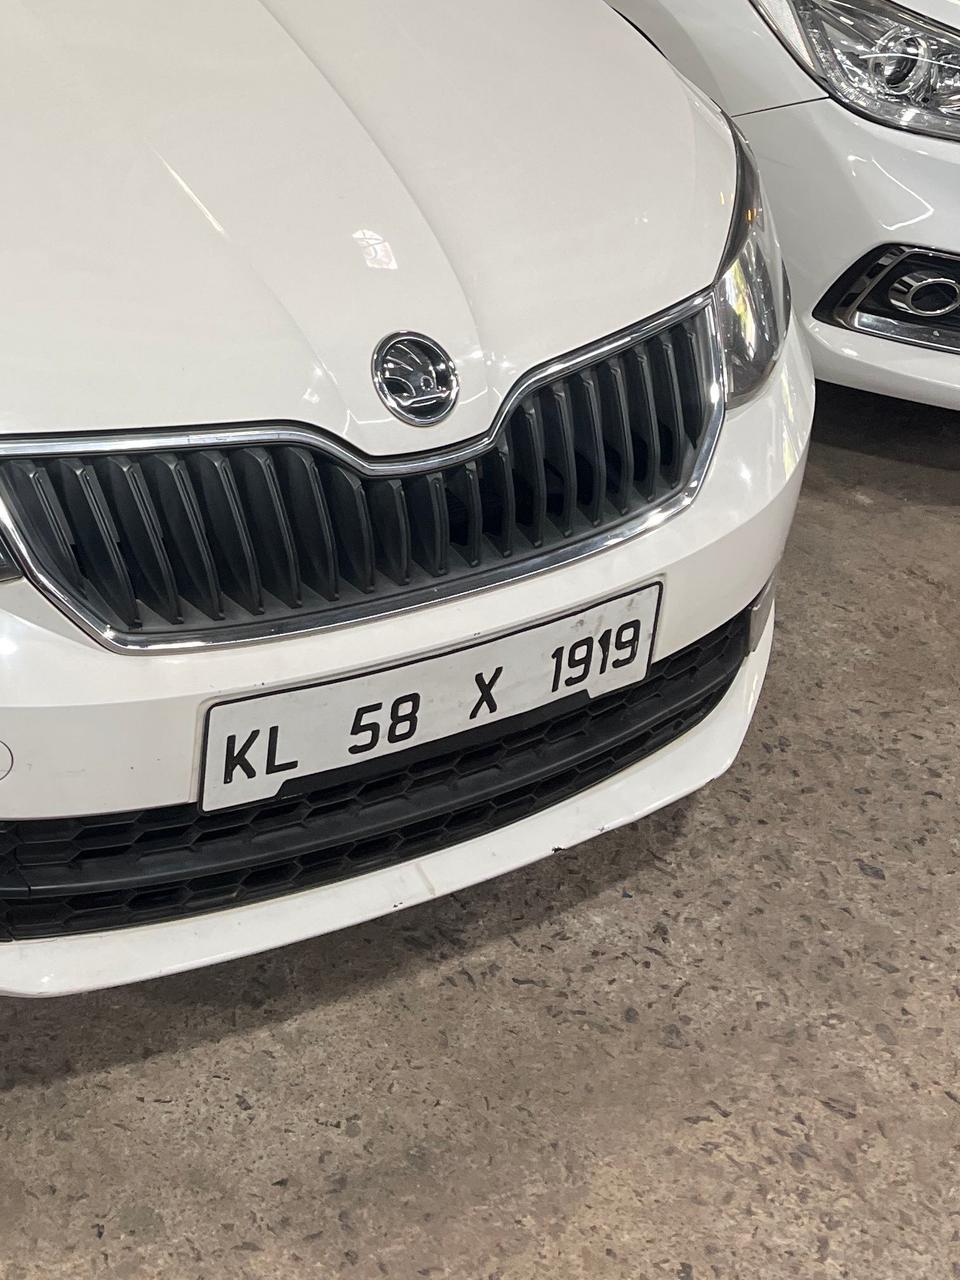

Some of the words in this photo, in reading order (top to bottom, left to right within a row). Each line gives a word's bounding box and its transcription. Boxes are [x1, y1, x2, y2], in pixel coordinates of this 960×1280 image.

[223, 725, 298, 784] KL
[348, 692, 421, 755] 58
[469, 666, 503, 720] X
[551, 619, 641, 692] 1919
